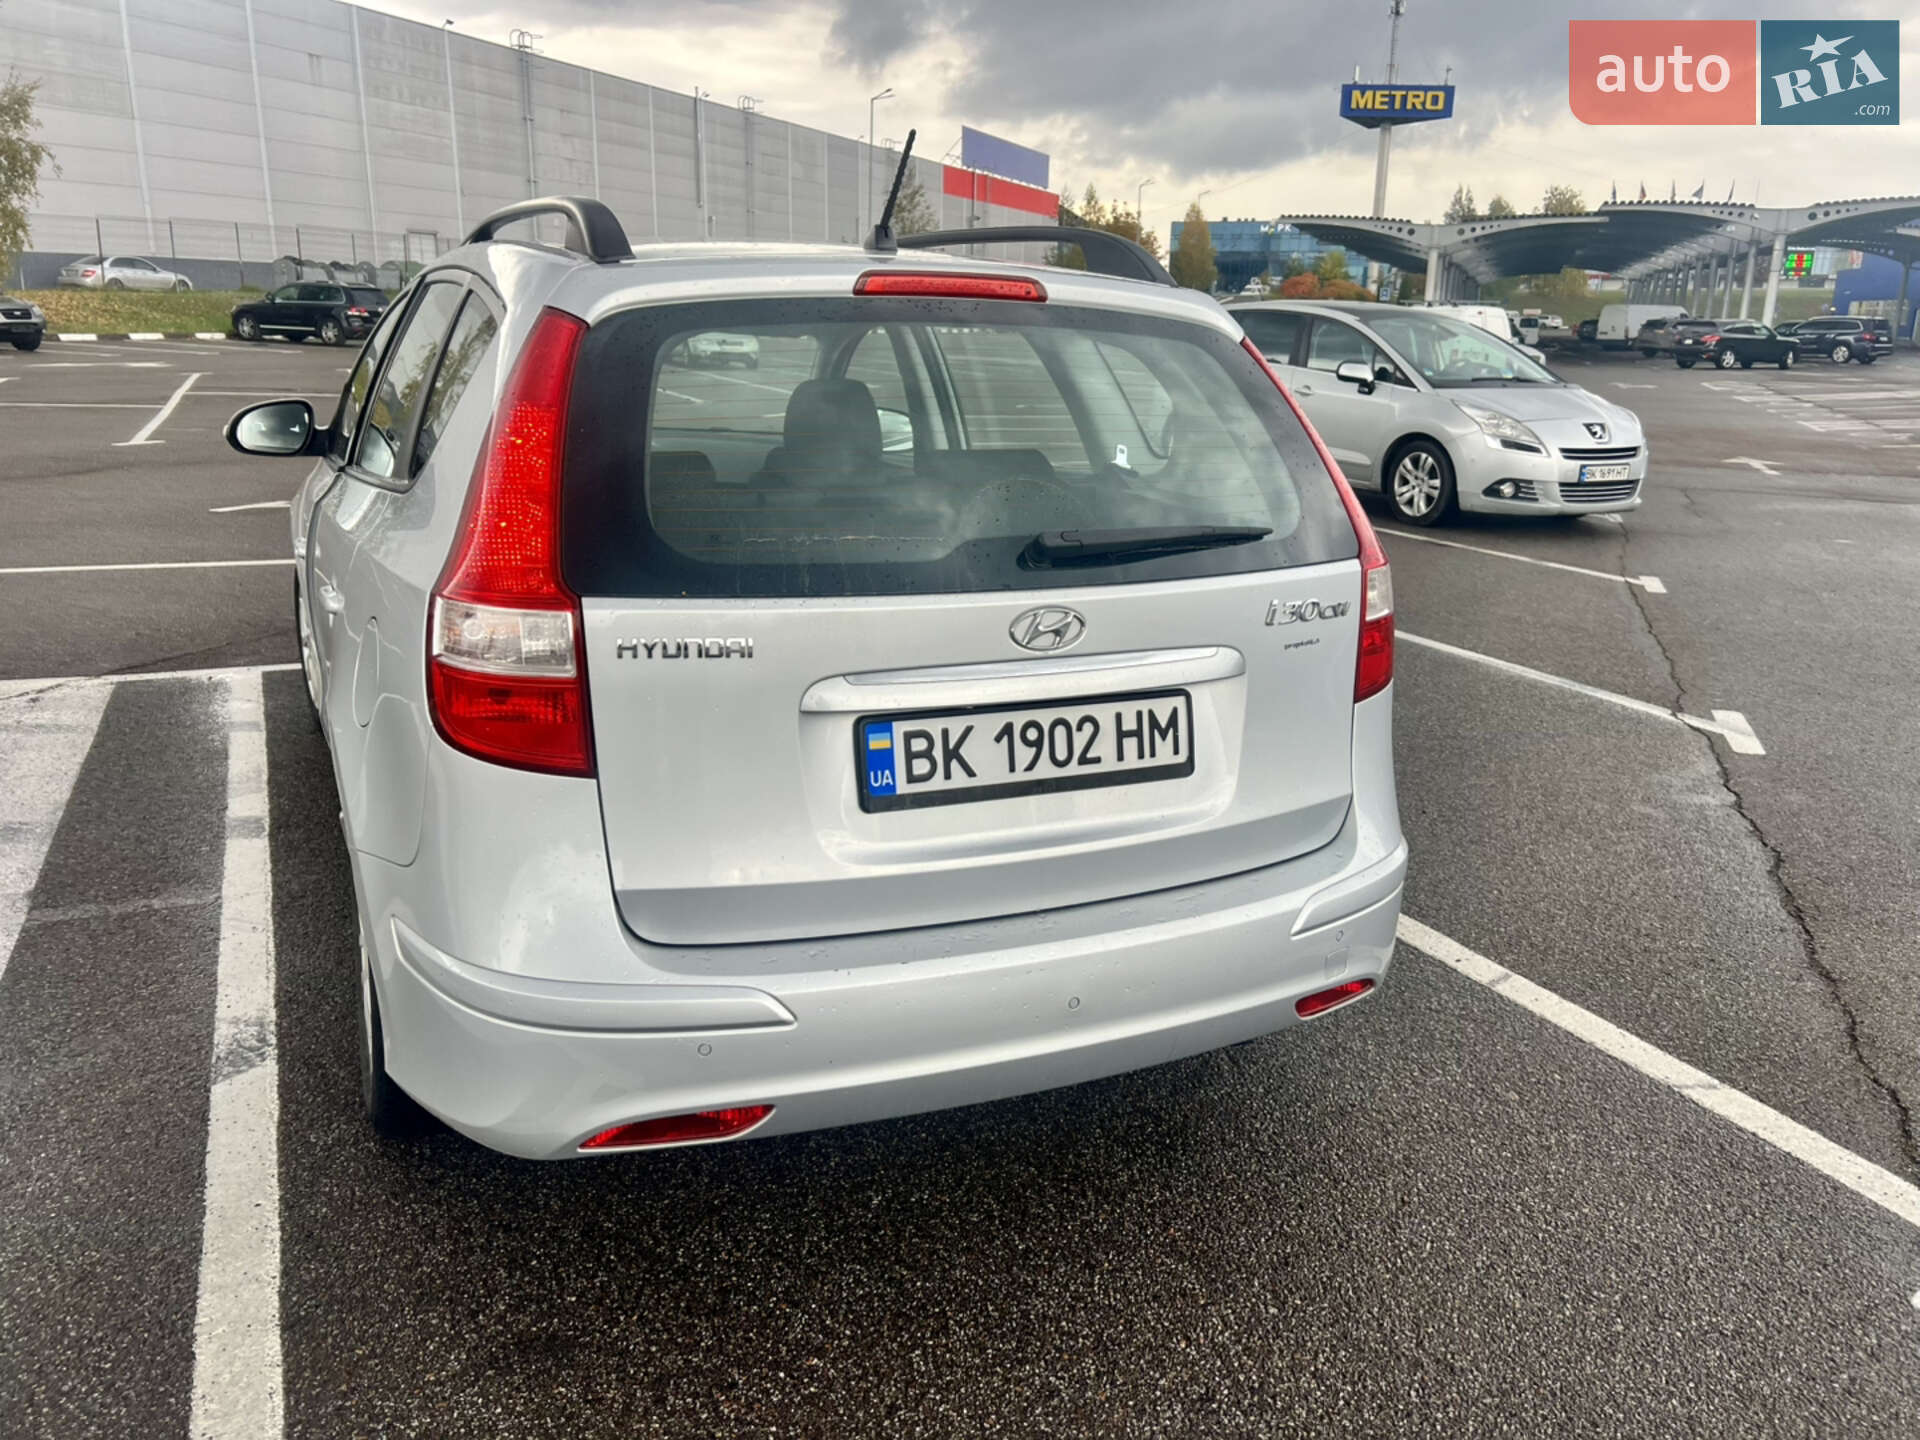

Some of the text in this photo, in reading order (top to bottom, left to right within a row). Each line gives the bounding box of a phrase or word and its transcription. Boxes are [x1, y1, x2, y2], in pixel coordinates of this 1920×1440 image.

[1350, 89, 1446, 111] METRO
[616, 637, 754, 660] HYUNDAI
[903, 706, 1180, 785] BK 1902 HM
[869, 769, 894, 788] UA
